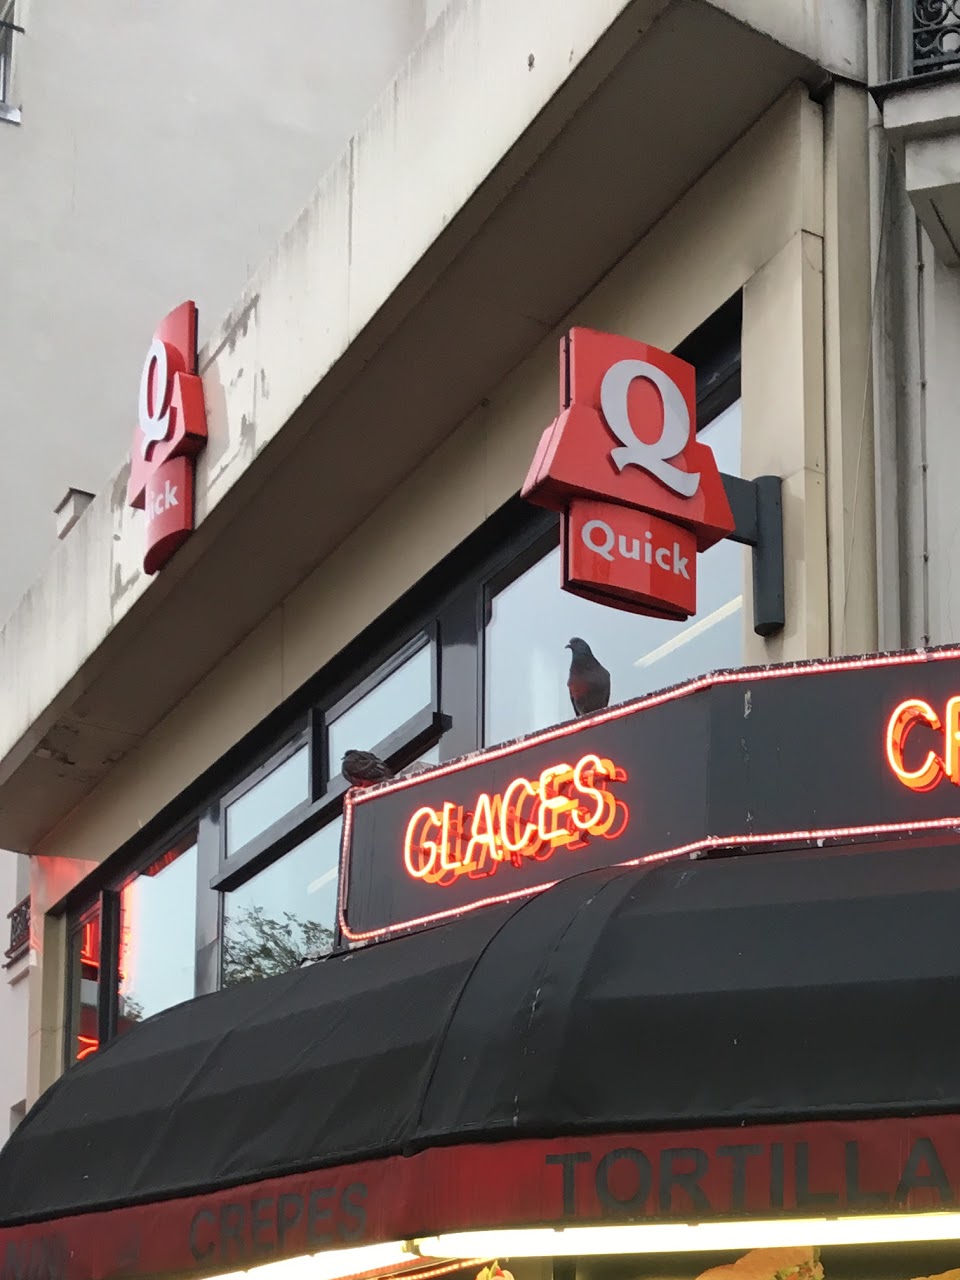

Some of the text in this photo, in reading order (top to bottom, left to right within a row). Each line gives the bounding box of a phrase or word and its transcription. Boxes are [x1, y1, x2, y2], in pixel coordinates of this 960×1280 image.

[600, 359, 700, 497] Q
[150, 479, 179, 521] ick
[581, 519, 691, 580] Quick
[404, 754, 618, 881] GLACES
